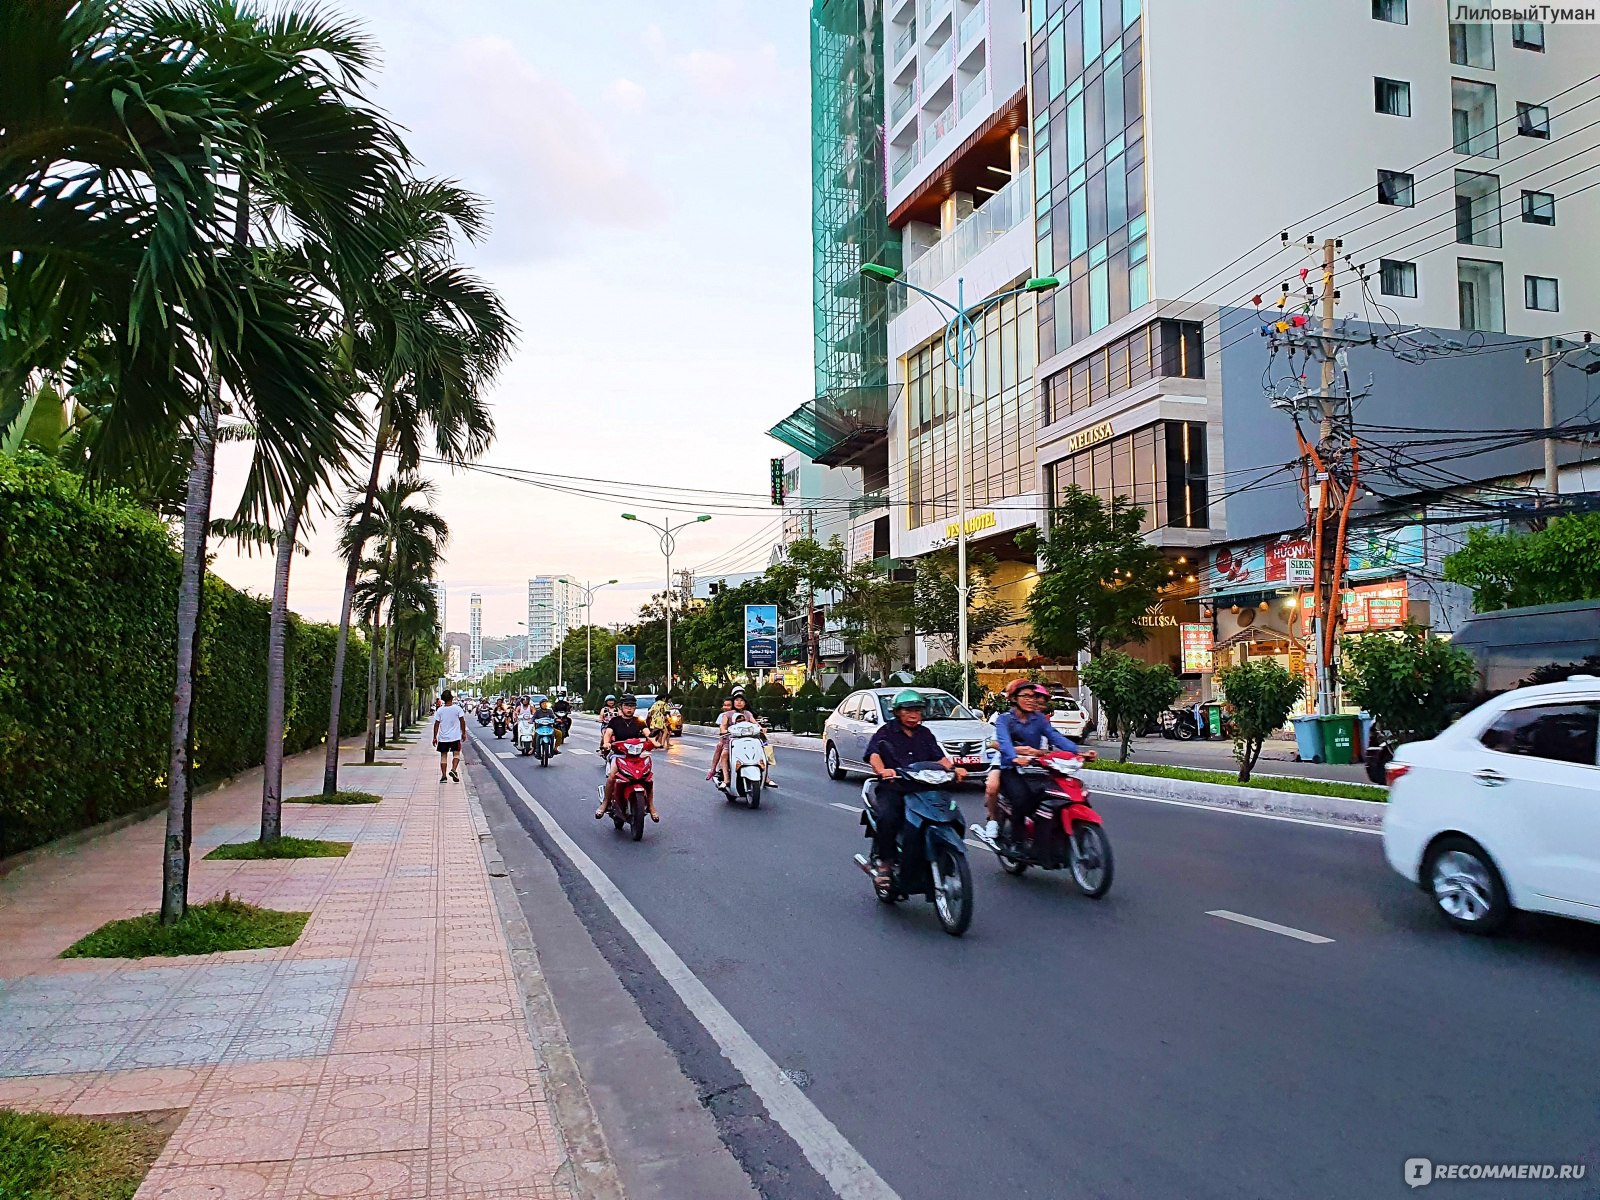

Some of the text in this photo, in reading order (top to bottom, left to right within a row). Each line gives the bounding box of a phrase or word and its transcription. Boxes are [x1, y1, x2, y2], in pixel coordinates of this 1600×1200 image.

[1069, 421, 1114, 452] MELISSA
[946, 511, 997, 539] VESA HOTEL
[1290, 560, 1315, 569] SIREN
